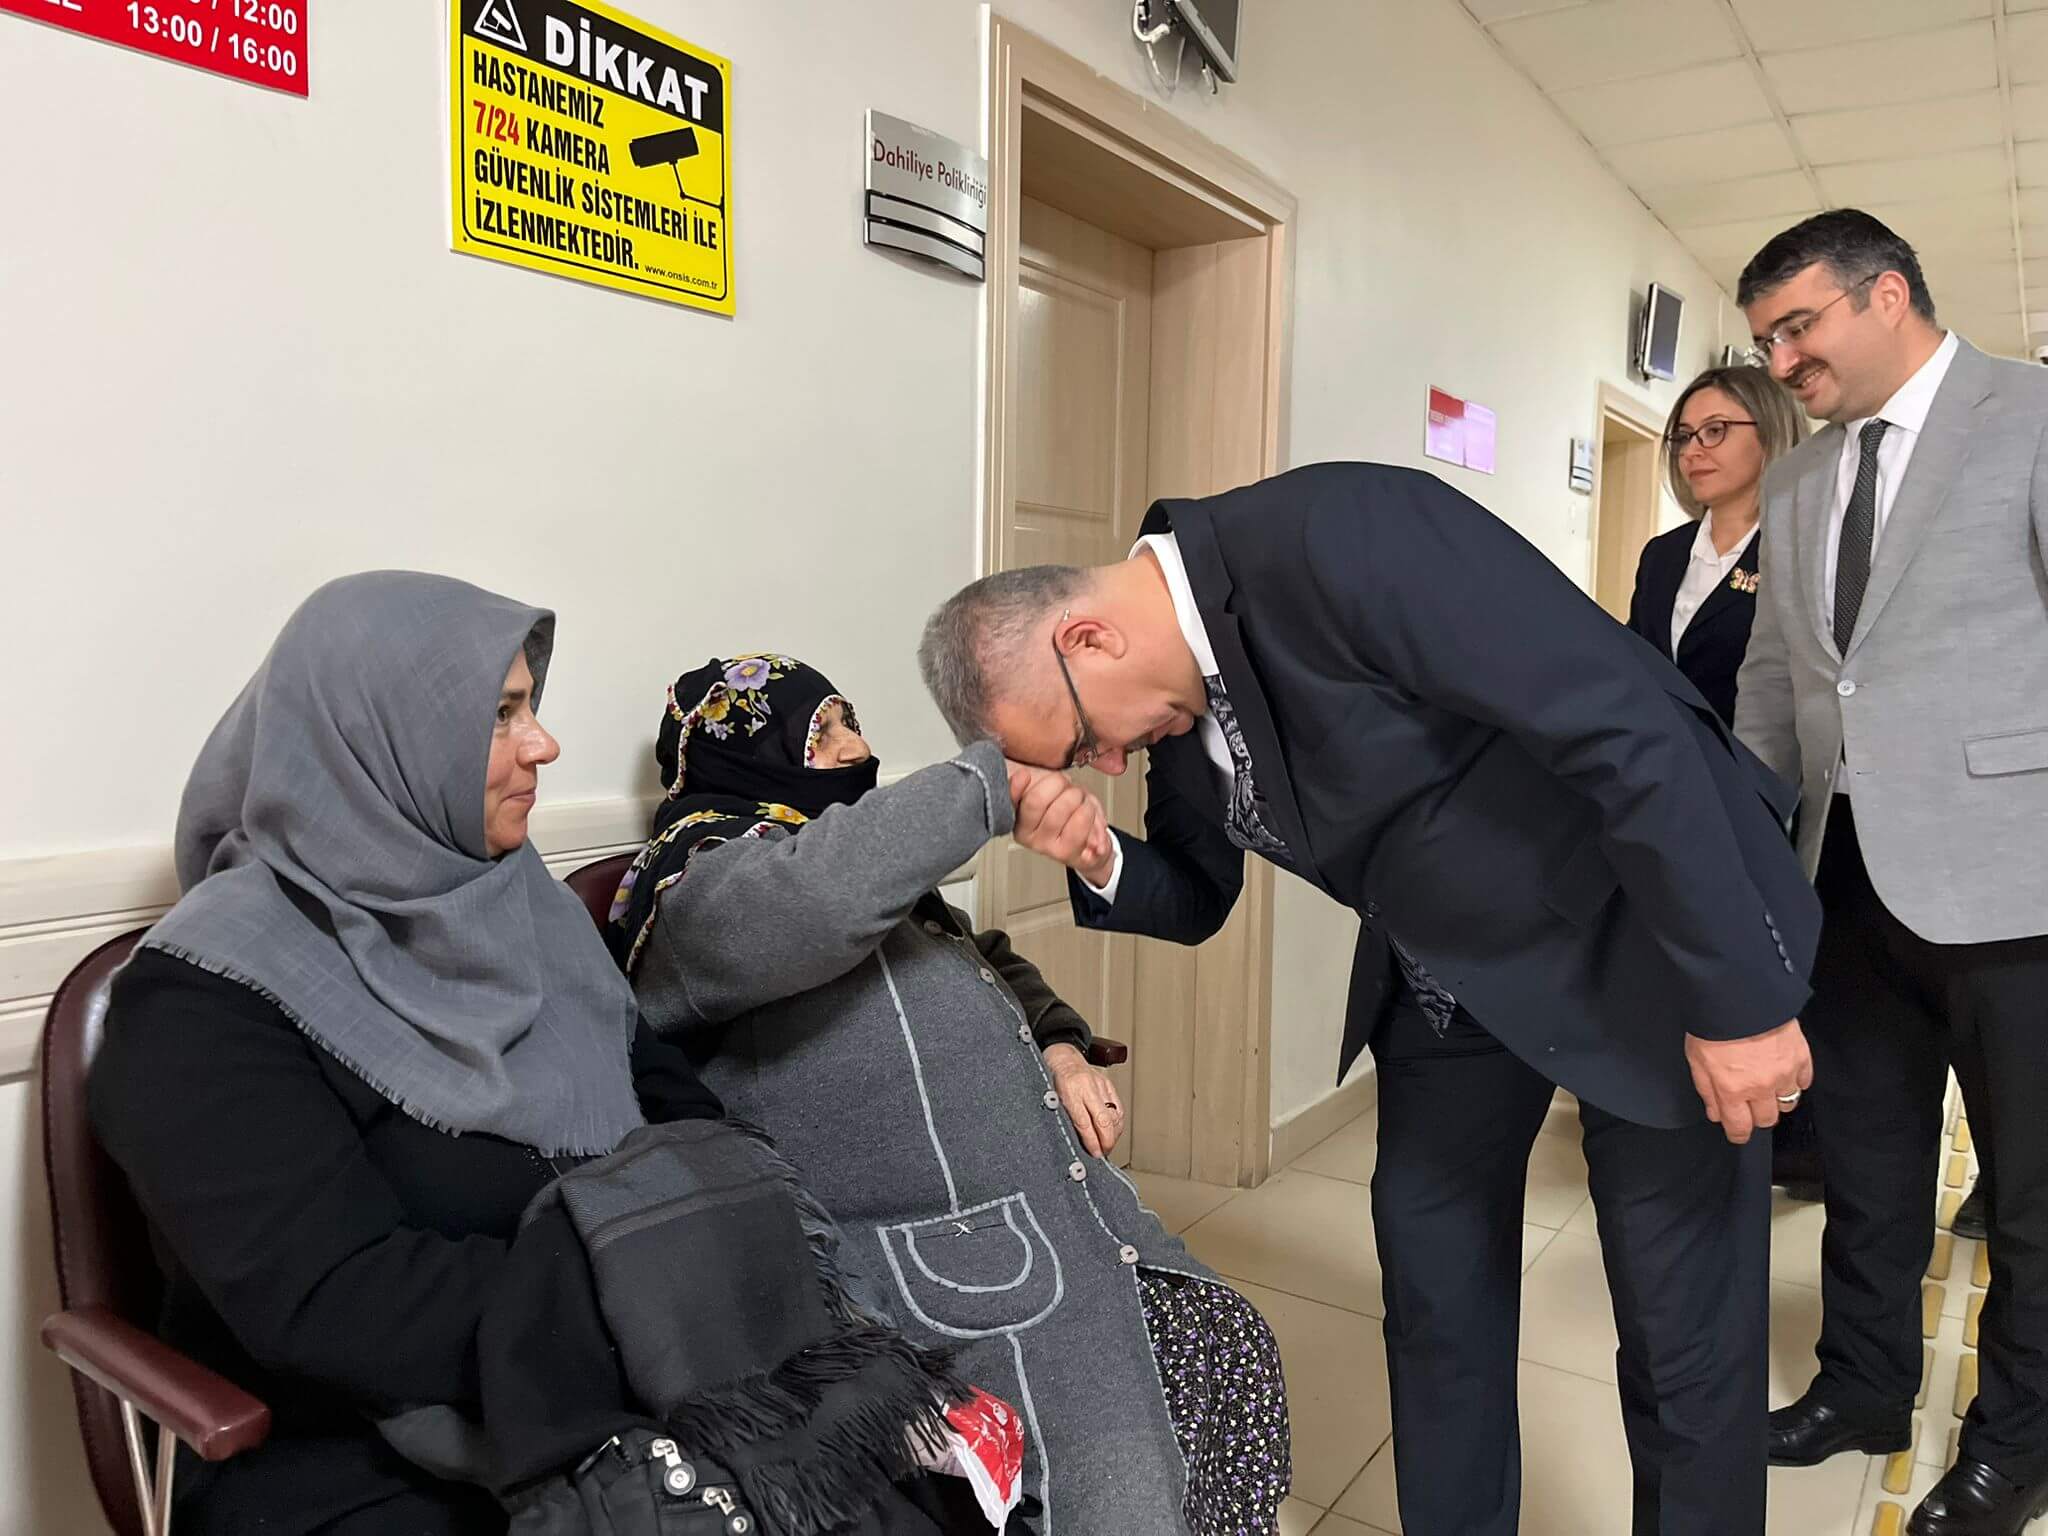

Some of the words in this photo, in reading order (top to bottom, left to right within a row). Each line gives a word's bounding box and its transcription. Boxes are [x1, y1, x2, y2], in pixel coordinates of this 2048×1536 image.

[127, 1, 203, 48] 13:00
[210, 26, 220, 53] /
[228, 33, 297, 77] 16:00
[545, 14, 708, 120] DİKKAT
[473, 50, 604, 128] HASTANEMİZ
[473, 100, 520, 146] 7/24
[526, 117, 610, 175] KAMERA
[873, 139, 933, 181] Dahiliye
[938, 161, 987, 208] Polikliniği
[474, 147, 575, 209] GÜVENLİK
[582, 179, 688, 242] SİSTEMLERİ
[693, 210, 717, 250] İLE
[475, 190, 639, 270] İZLENMEKTEDİR.
[645, 265, 718, 290] www.onsis.com.tr
